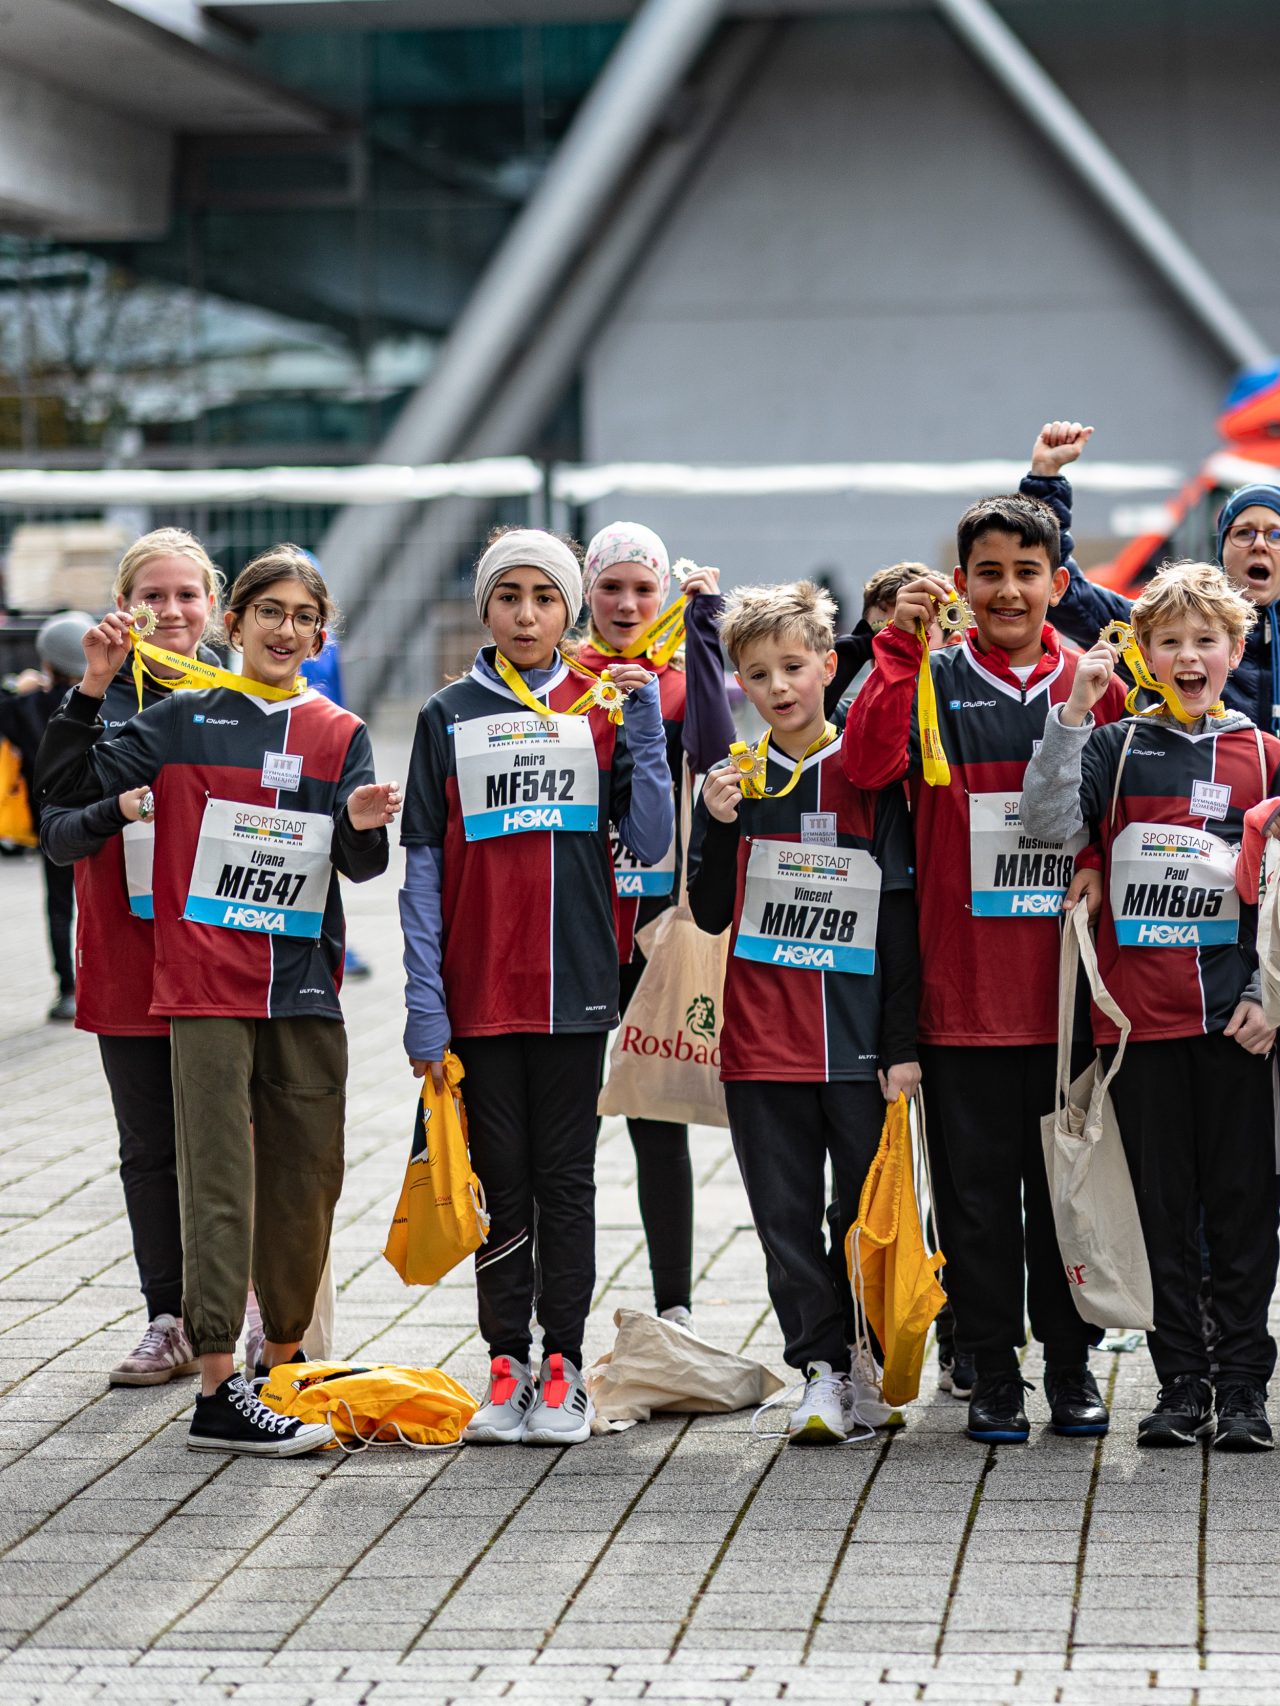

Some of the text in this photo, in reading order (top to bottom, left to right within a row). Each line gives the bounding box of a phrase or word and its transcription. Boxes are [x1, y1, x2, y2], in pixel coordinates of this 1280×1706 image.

[165, 655, 217, 678] MINI-MARATHON
[487, 721, 559, 736] SPORTSTADT
[489, 740, 527, 748] FRANKFURT
[513, 753, 545, 768] Amira
[264, 770, 299, 780] GYMNASIUM
[486, 769, 575, 809] MF542
[1192, 798, 1227, 808] GYMNASIUM
[234, 812, 307, 834] SPORTSTADT
[503, 809, 563, 832] HOKA
[232, 832, 271, 843] FRANKFURT
[1141, 832, 1213, 853] SPORTSTADT
[250, 850, 285, 868] Liyana
[778, 851, 851, 870] SPORTSTADT
[777, 870, 815, 880] FRANKFURT
[993, 854, 1073, 887] MM818
[1165, 867, 1189, 881] Paul
[215, 864, 307, 906] MF547
[794, 887, 832, 904] Vincent
[1121, 883, 1224, 918] MM805
[222, 906, 286, 931] HOKA
[760, 902, 858, 943] MM798
[1137, 924, 1200, 944] HOKA
[772, 944, 834, 968] HOKA
